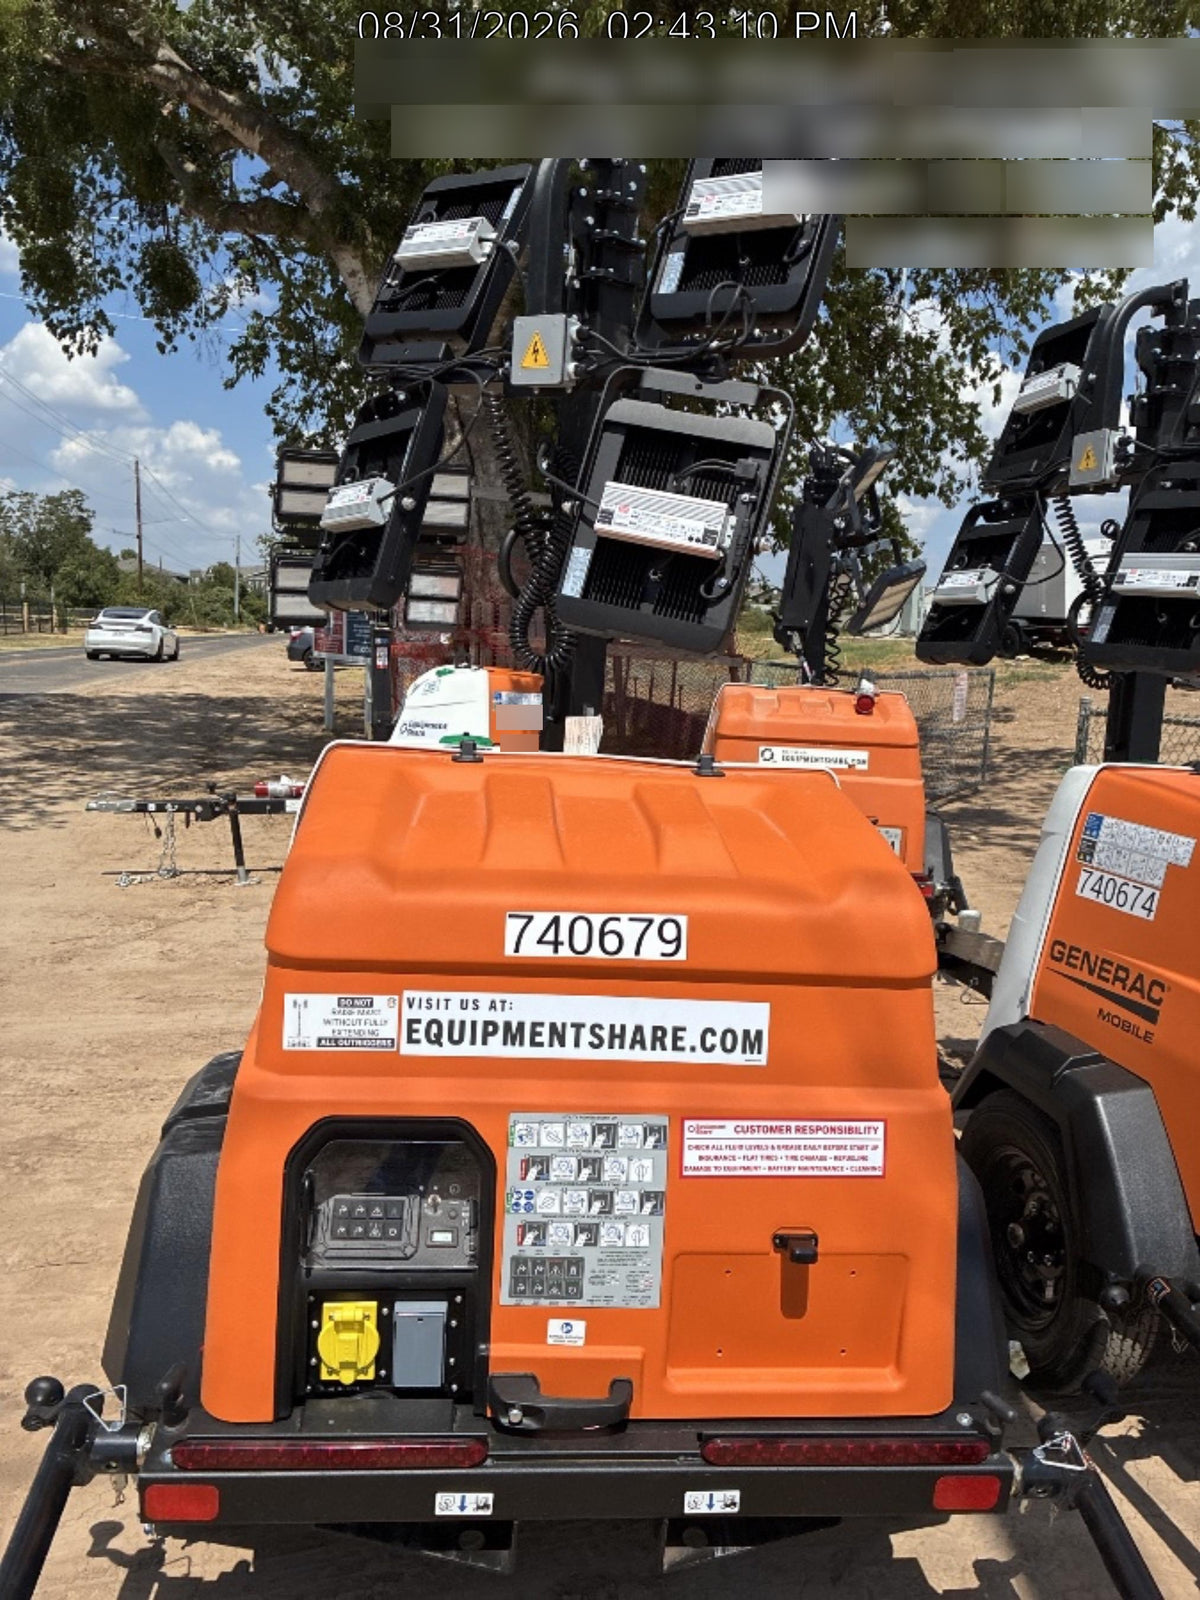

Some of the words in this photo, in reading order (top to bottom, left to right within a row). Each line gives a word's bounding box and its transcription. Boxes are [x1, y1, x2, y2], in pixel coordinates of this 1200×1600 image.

[1079, 868, 1157, 918] 740674
[507, 913, 683, 958] 740679
[1049, 939, 1167, 1007] GENERAC
[340, 998, 352, 1007] DO
[353, 998, 372, 1007] NOT
[406, 997, 452, 1011] VISIT
[459, 998, 480, 1011] US
[488, 999, 514, 1012] AT:
[323, 1018, 362, 1026] WITHOUT
[364, 1019, 388, 1027] FULLY
[1097, 1007, 1155, 1044] MOBILE
[332, 1029, 380, 1037] EXTENDING
[405, 1018, 764, 1055] EQUIPMENTSHARE.COM
[319, 1038, 336, 1046] ALL
[734, 1124, 792, 1135] CUSTOMER
[794, 1125, 880, 1135] RESPONSIBILITY
